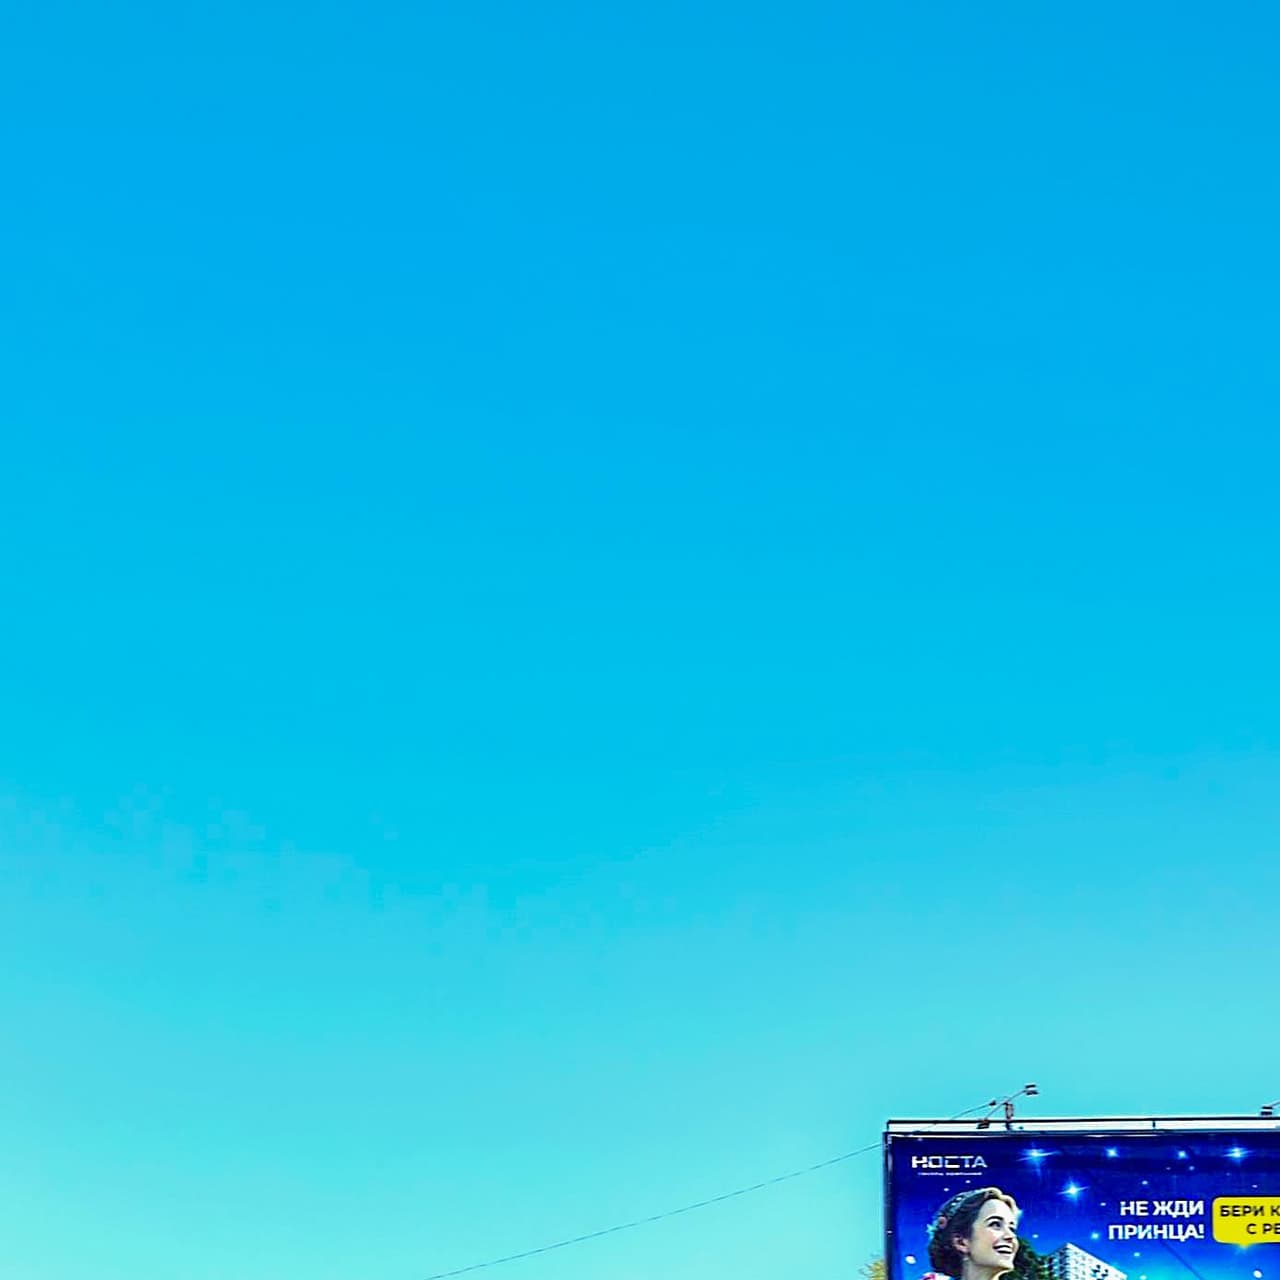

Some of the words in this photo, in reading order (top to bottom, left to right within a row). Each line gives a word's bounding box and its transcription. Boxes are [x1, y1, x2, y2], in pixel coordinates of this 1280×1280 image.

[1120, 1200, 1149, 1216] НЕ
[1152, 1200, 1204, 1218] ЖДИ
[1220, 1204, 1264, 1217] БЕРИ
[1108, 1224, 1205, 1242] ПРИНЦА!
[1246, 1223, 1257, 1235] С
